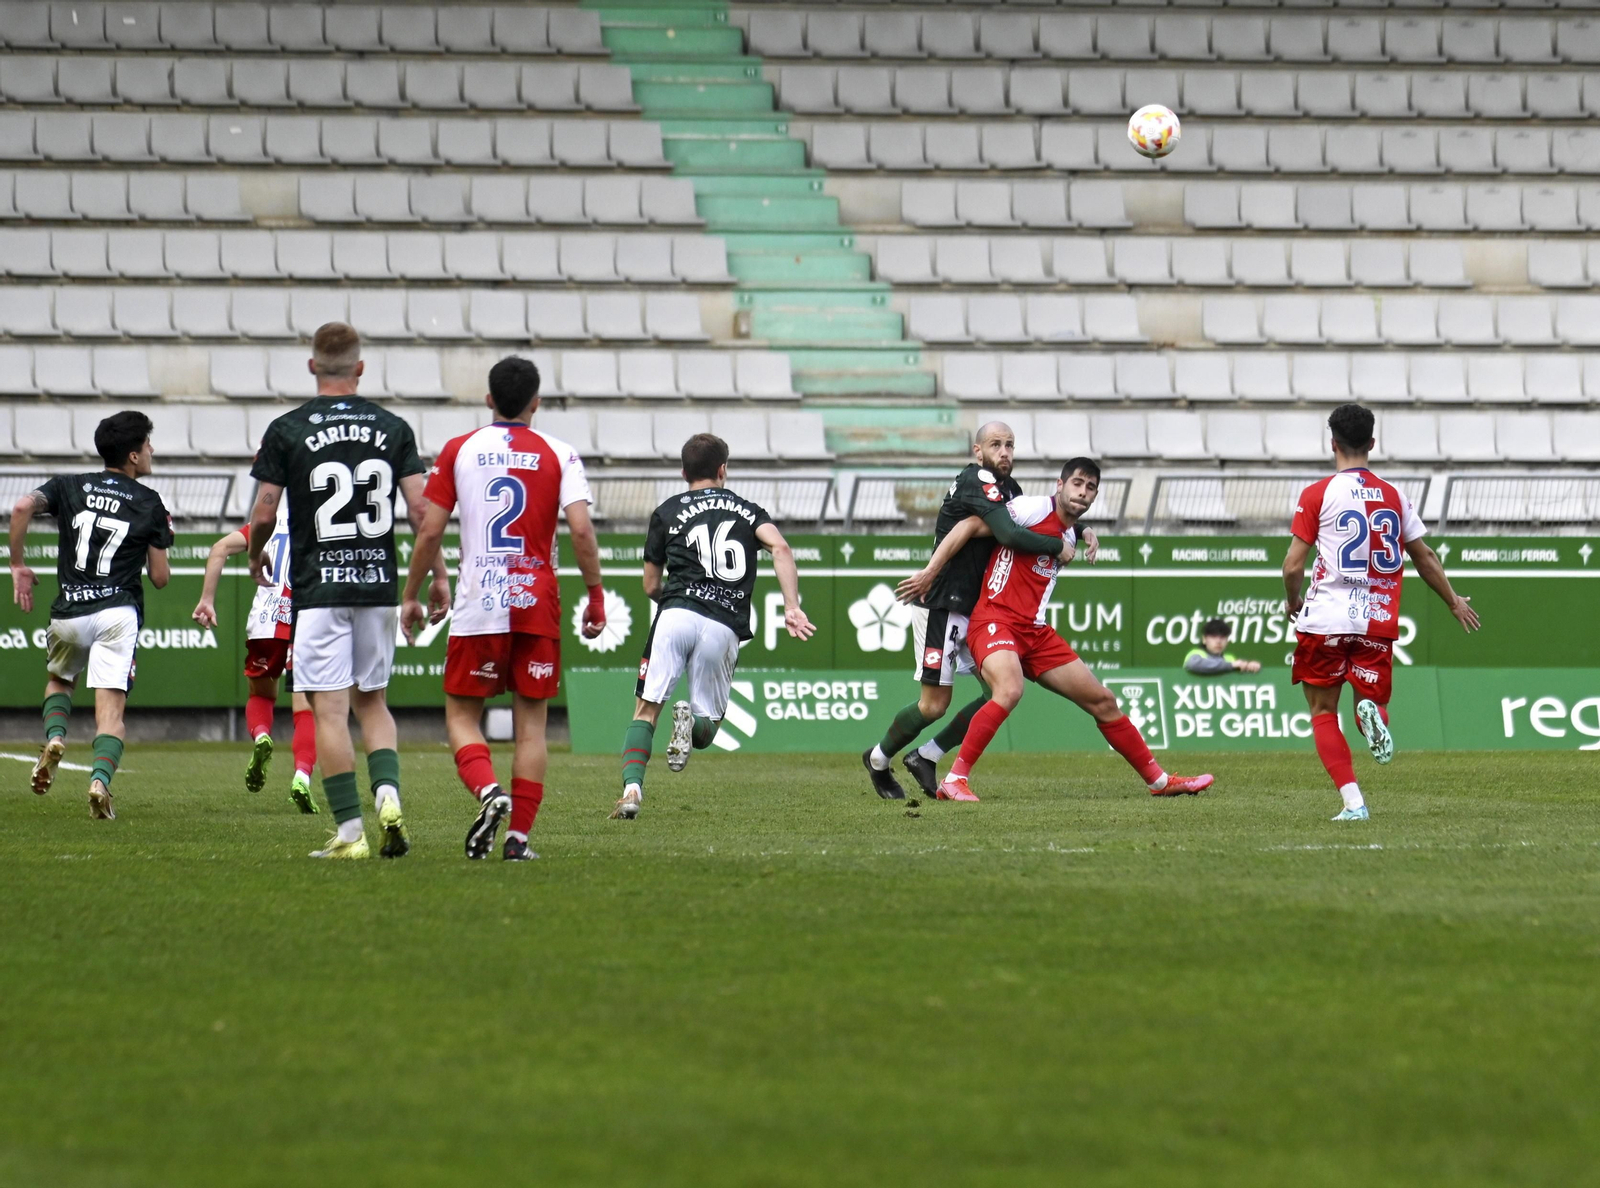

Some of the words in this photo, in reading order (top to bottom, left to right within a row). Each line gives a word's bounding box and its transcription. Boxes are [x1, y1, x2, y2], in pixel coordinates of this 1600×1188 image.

[304, 424, 372, 452] CARLOS
[373, 430, 387, 451] V.
[86, 494, 121, 514] COTO
[309, 458, 393, 543] 23
[1351, 488, 1382, 500] MENA
[485, 475, 525, 554] 2
[676, 498, 756, 526] MANZANARA
[72, 509, 130, 577] 17
[685, 520, 746, 581] 16
[1335, 509, 1402, 573] 23
[319, 548, 387, 566] reganosa
[613, 548, 635, 560] CLUB
[873, 548, 910, 561] RACING
[1172, 549, 1208, 561] RACING
[1208, 550, 1230, 561] CLUB
[1231, 549, 1269, 561] FERROL
[1461, 550, 1498, 562] RACING
[1499, 551, 1520, 562] CLUB
[1521, 550, 1560, 562] FERROL
[987, 623, 997, 636] 9
[763, 681, 879, 700] DEPORTE
[1172, 684, 1276, 710] XUNTA
[765, 701, 869, 721] GALEGO
[1174, 712, 1214, 738] DE
